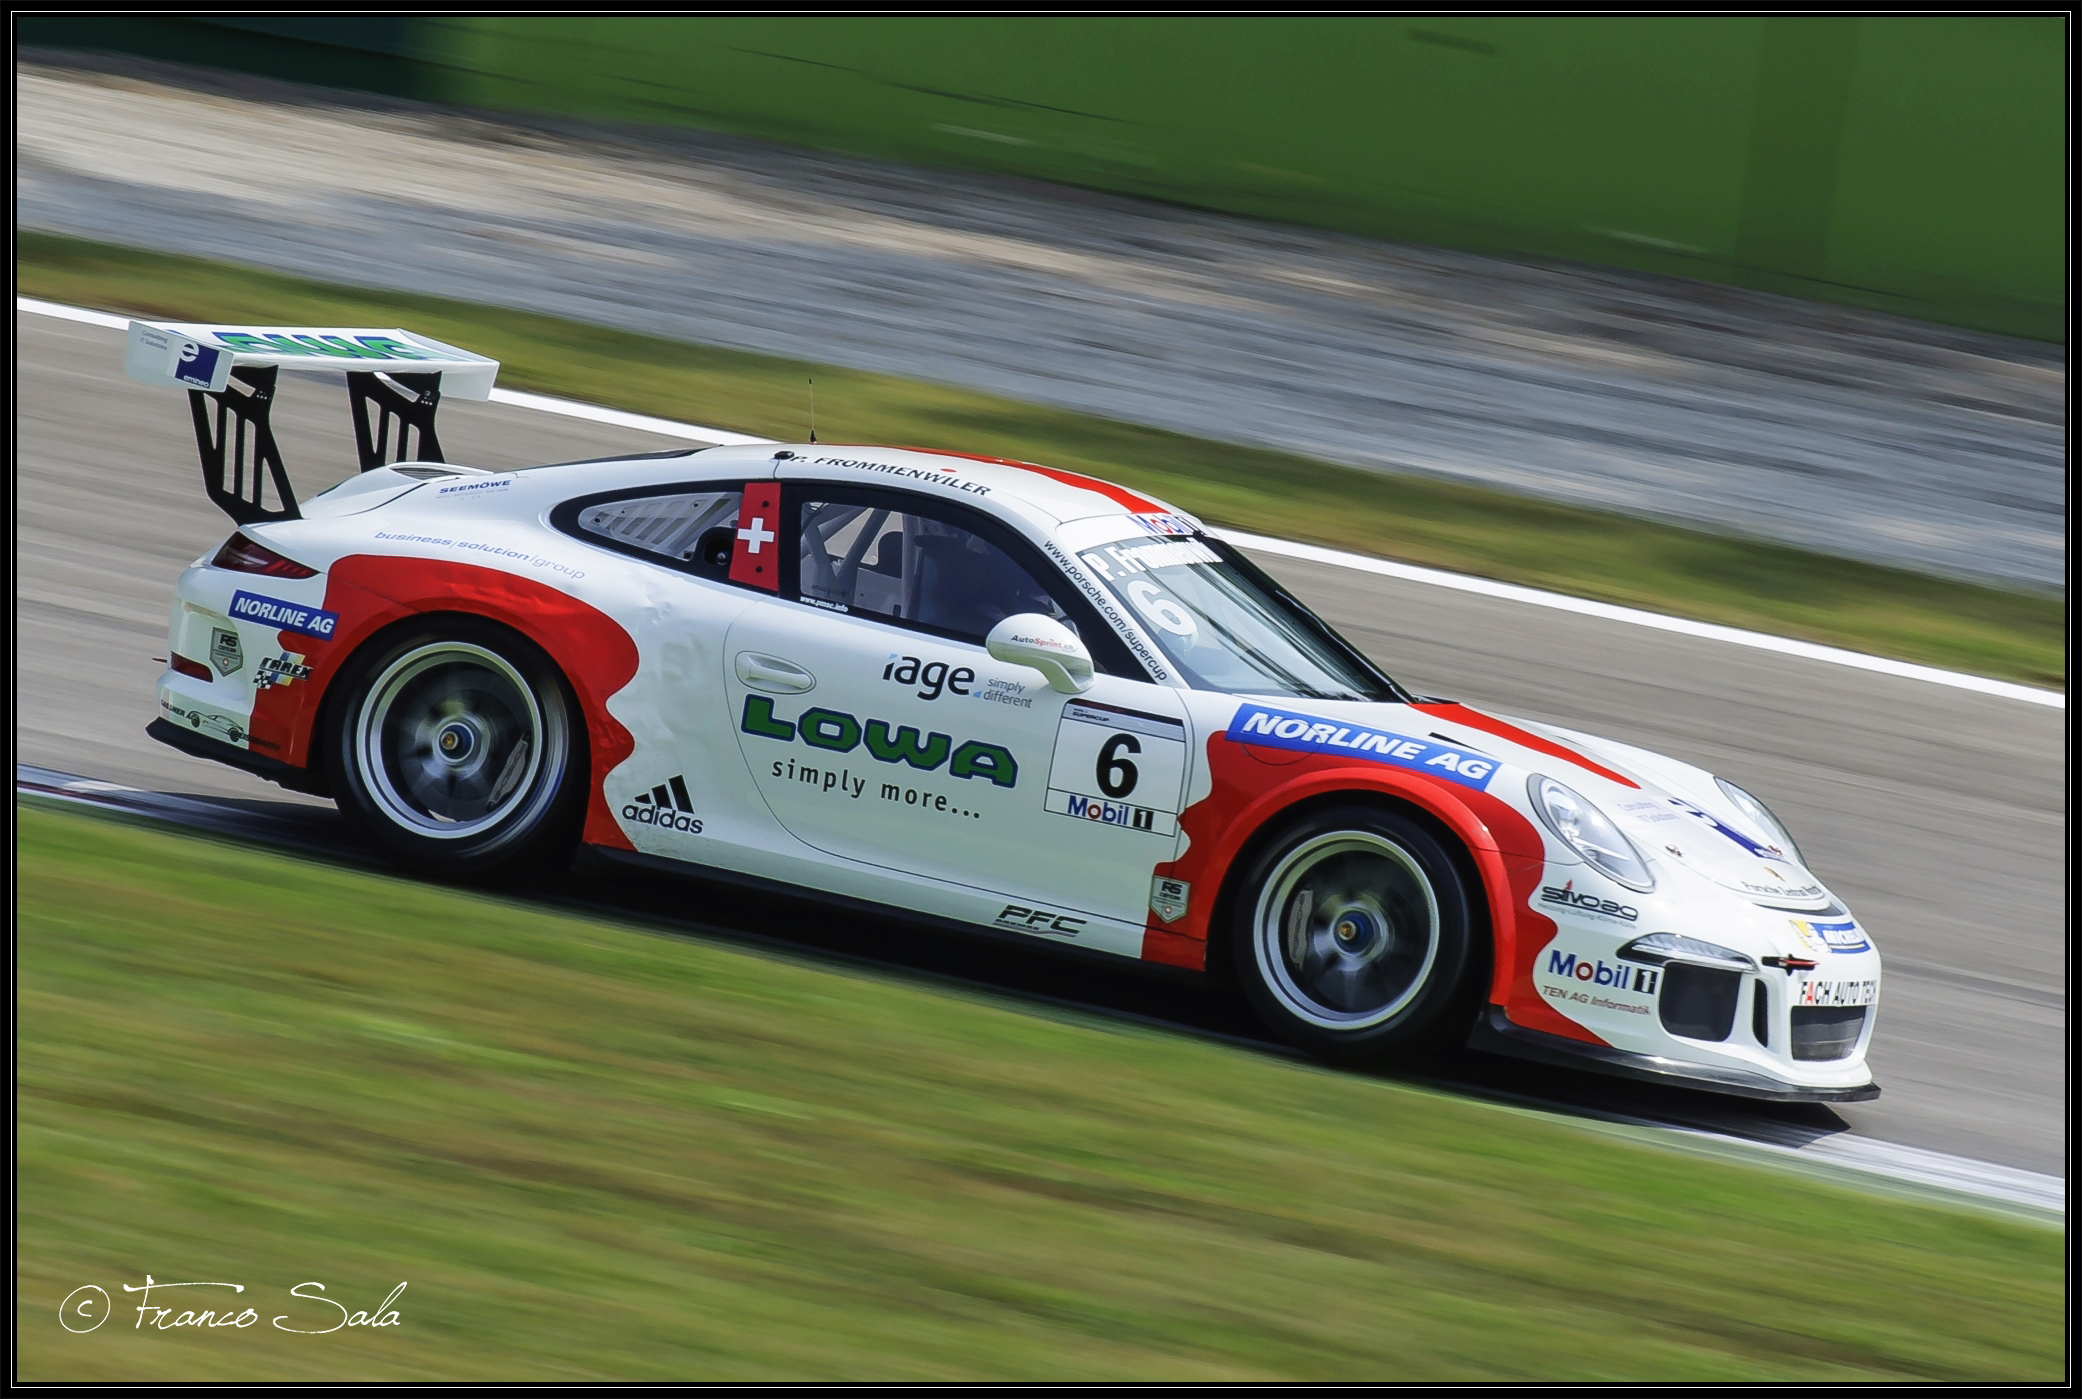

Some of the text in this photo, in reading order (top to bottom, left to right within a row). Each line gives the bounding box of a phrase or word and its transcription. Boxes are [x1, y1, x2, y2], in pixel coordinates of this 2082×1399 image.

[183, 374, 210, 389] emineo
[438, 479, 512, 494] SEEMÖWE
[813, 457, 992, 496] FROMMENWILER
[1081, 552, 1127, 582] P.
[235, 597, 334, 634] NORLINE AG
[1044, 540, 1168, 682] www.porsche.com/supercup
[1126, 580, 1198, 635] 6
[219, 633, 238, 647] RS
[882, 653, 976, 701] iage
[987, 676, 1026, 695] simply
[983, 690, 1033, 708] different
[1072, 710, 1110, 722] SUPERCUP
[741, 693, 1019, 789] LOWA
[1242, 710, 1494, 780] NORLINE AG
[1096, 733, 1142, 799] 6
[771, 757, 981, 819] simply more...
[621, 804, 704, 835] adidas
[1067, 794, 1130, 826] Mobil
[1160, 880, 1183, 895] RS
[998, 904, 1088, 934] PFC
[1548, 949, 1632, 989] Mobil
[1542, 985, 1651, 1016] TEN AG Informatik
[1799, 981, 1832, 1005] FACH
[1832, 981, 1860, 1005] AUTO
